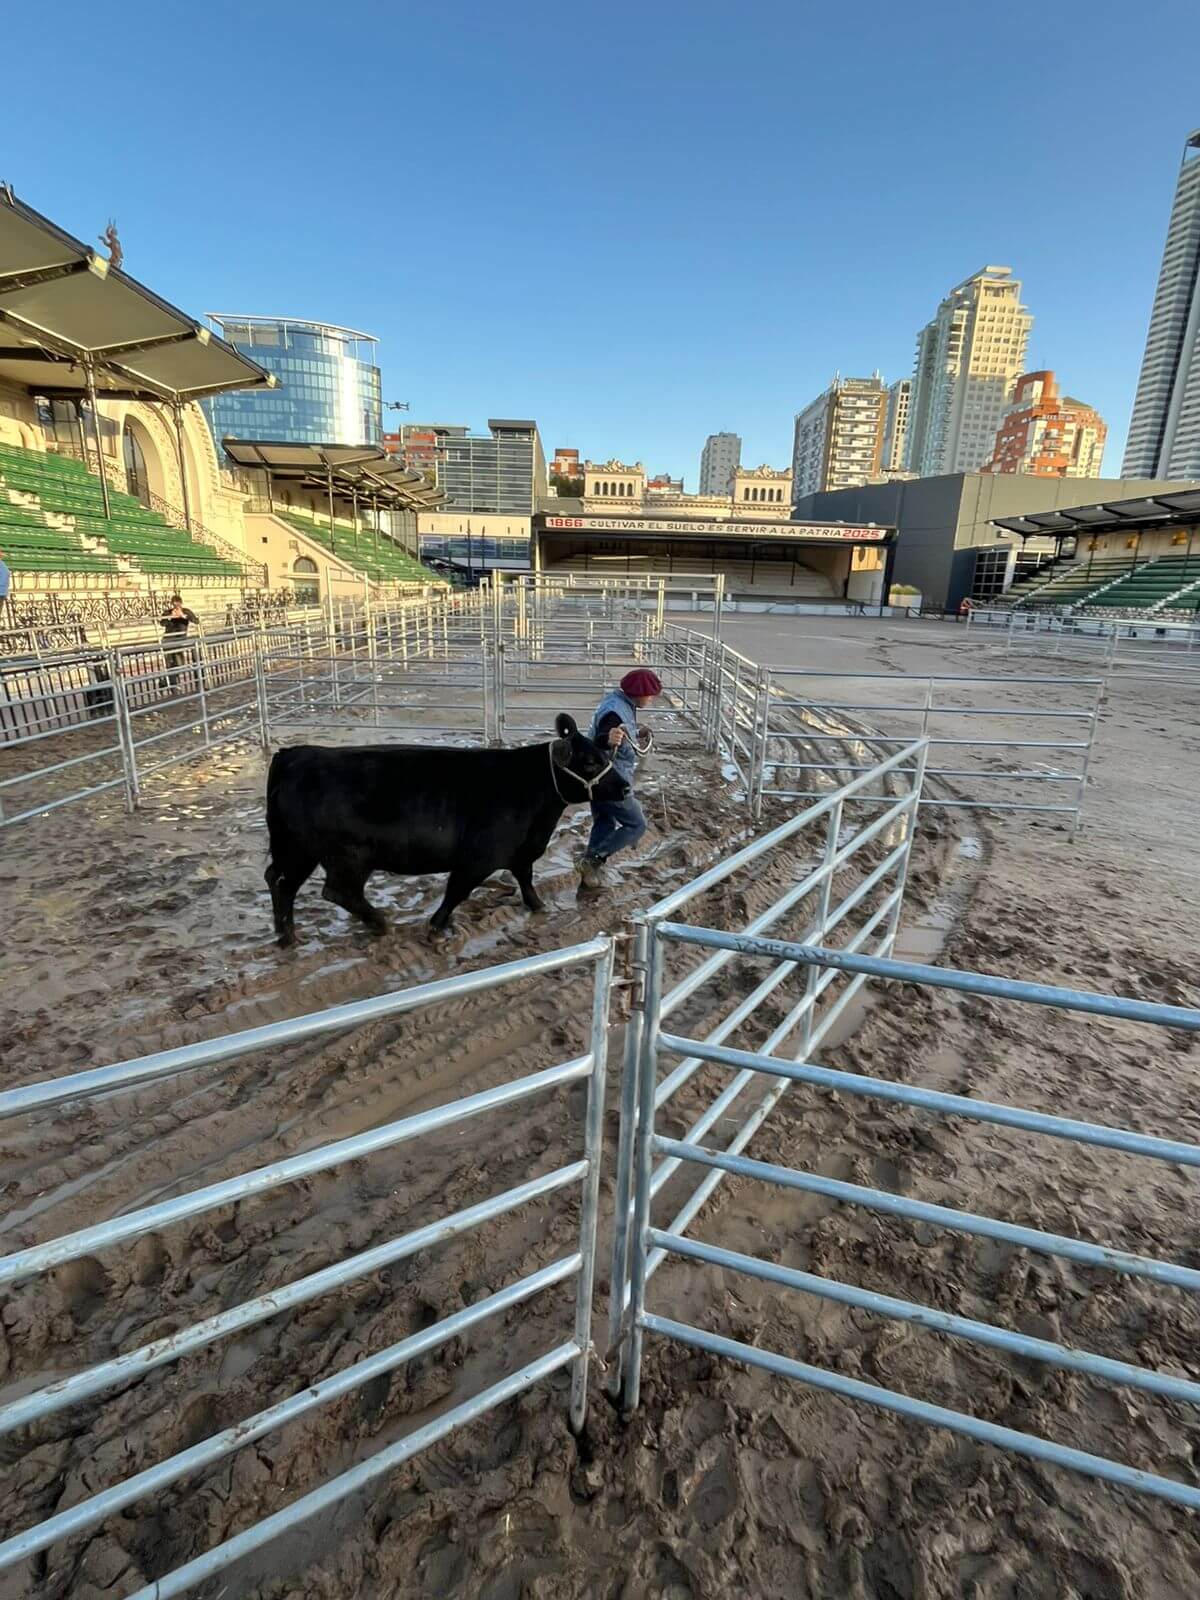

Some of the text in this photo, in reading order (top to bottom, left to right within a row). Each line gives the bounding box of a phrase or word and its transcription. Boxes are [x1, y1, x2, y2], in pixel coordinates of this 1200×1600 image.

[590, 520, 644, 529] CULTIVAR
[667, 523, 705, 531] SUELO
[726, 525, 766, 533] SERVIR
[799, 528, 841, 537] PATRIA
[842, 529, 880, 538] 2025
